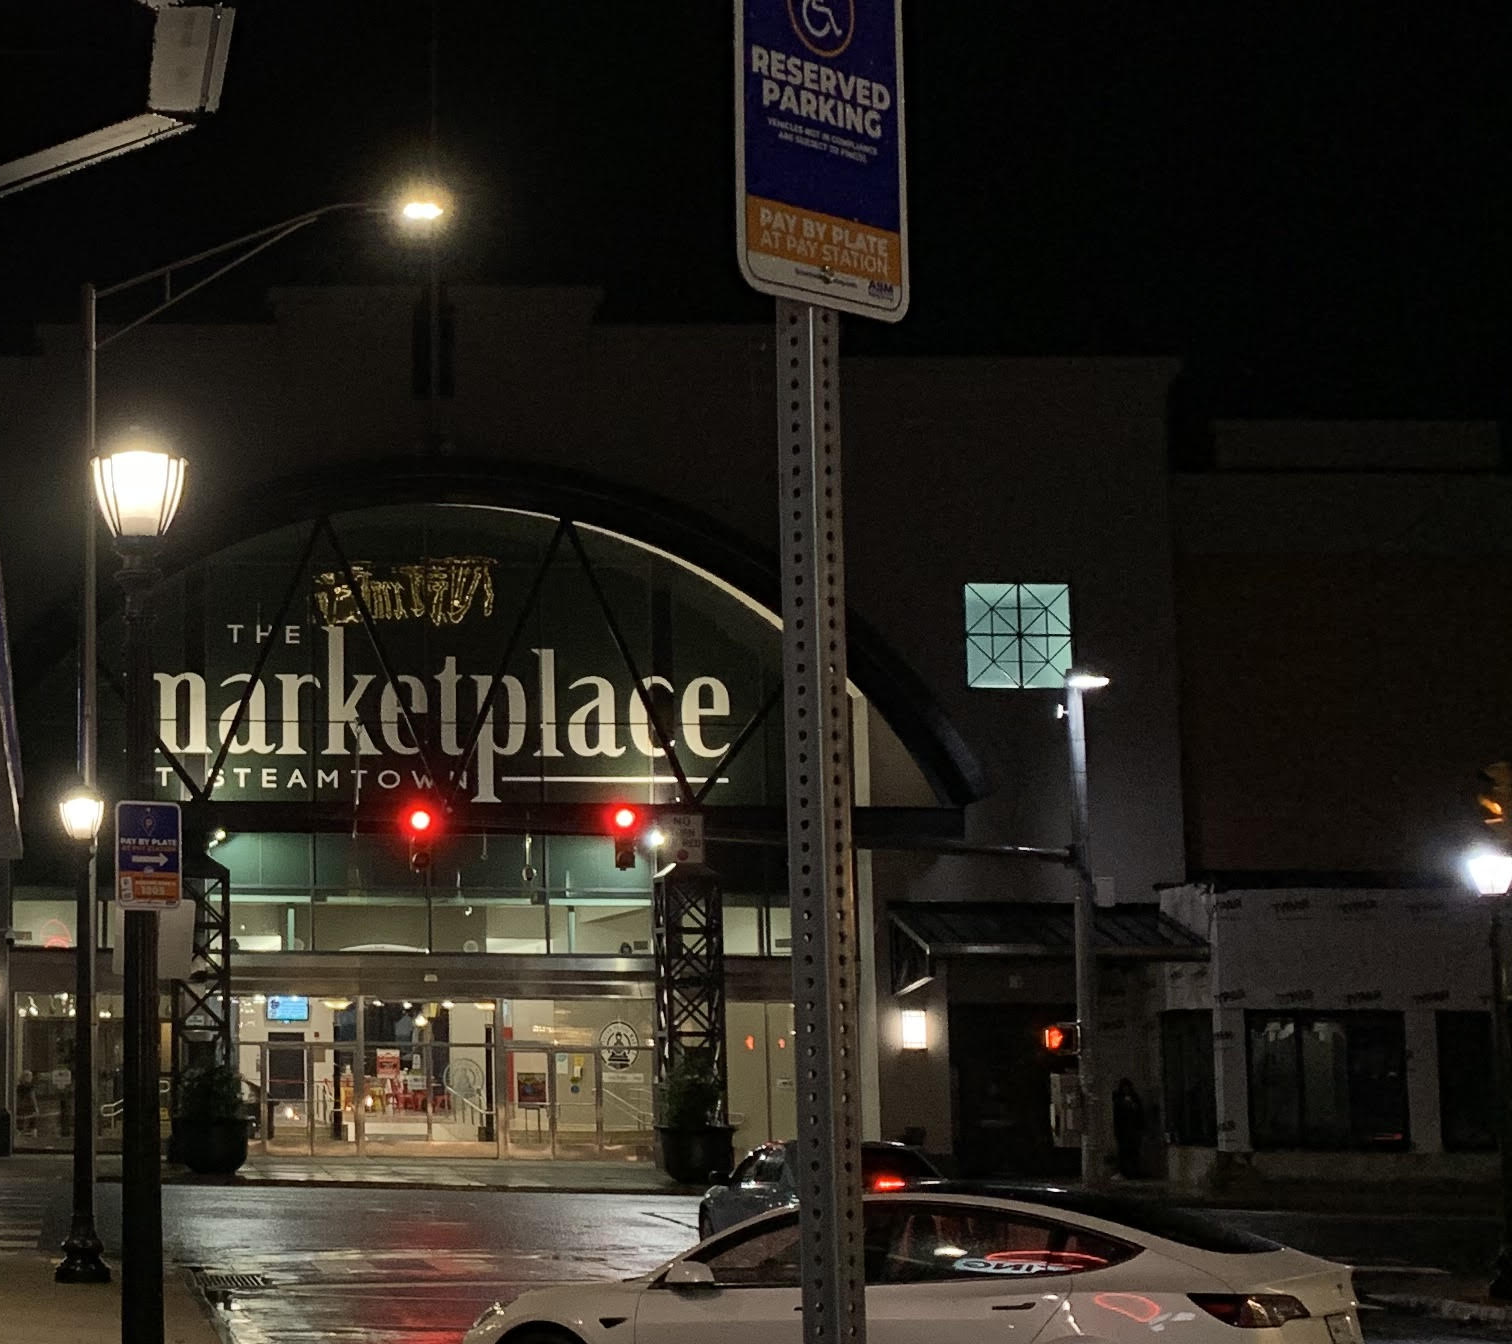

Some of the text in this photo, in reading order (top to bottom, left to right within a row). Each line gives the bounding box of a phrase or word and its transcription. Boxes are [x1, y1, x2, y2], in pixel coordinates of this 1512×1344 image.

[752, 44, 891, 110] RESERVED
[762, 78, 882, 139] PARKING
[759, 207, 888, 255] PAY BY PLATE
[760, 230, 888, 275] AT PAY STATION
[227, 624, 301, 644] THE
[120, 837, 137, 846] PAY
[151, 838, 177, 847] PLATE
[673, 816, 691, 826] NO
